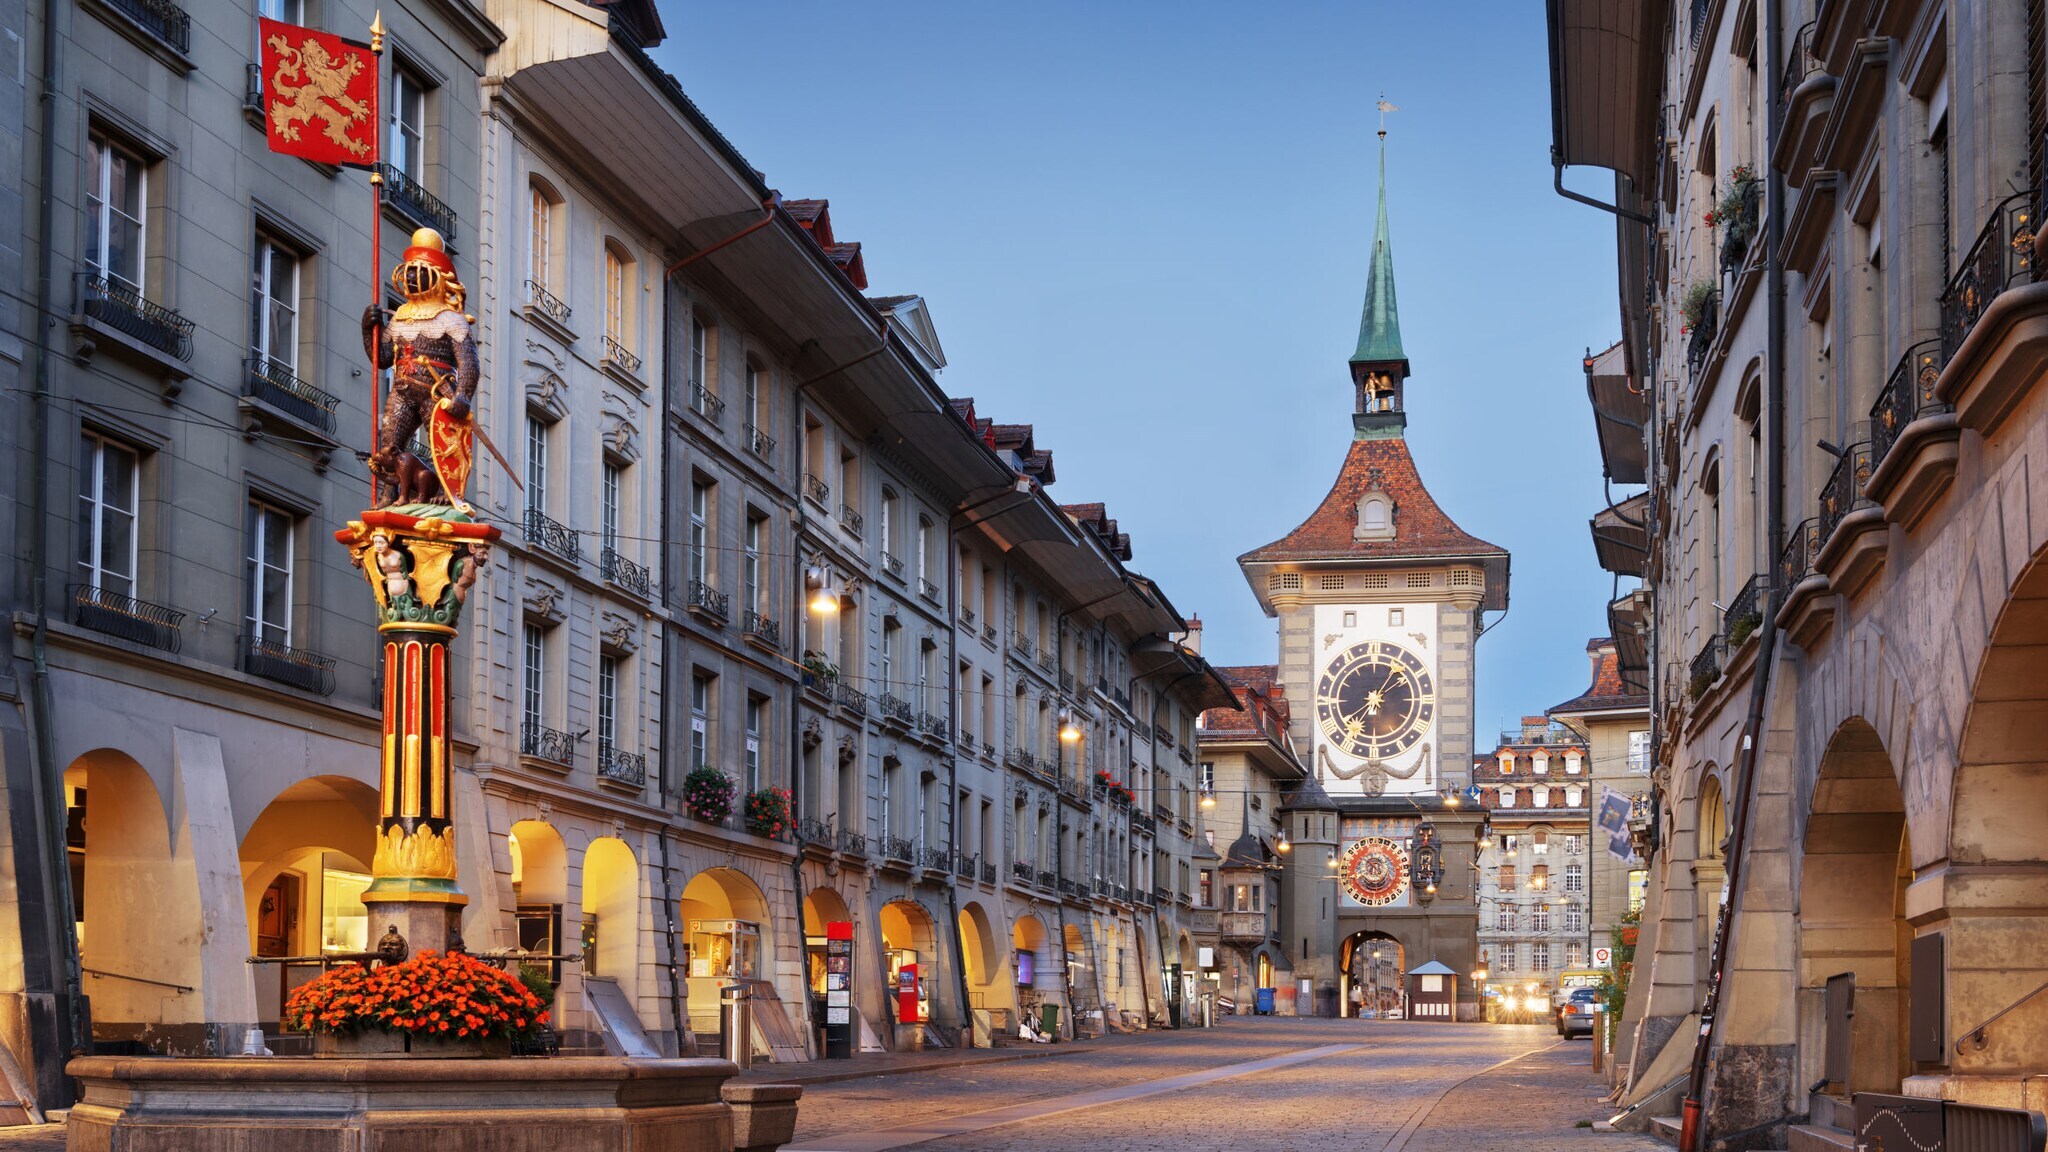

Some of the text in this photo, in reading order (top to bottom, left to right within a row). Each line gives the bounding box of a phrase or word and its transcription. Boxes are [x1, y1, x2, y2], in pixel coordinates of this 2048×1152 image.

[1367, 642, 1380, 654] XII
[1342, 649, 1354, 664] XI
[1398, 649, 1405, 660] I
[1324, 670, 1336, 681] X
[1415, 668, 1426, 678] II
[1317, 695, 1329, 706] IX
[1422, 694, 1434, 704] III
[1369, 746, 1379, 758] VI
[1396, 741, 1406, 752] V
